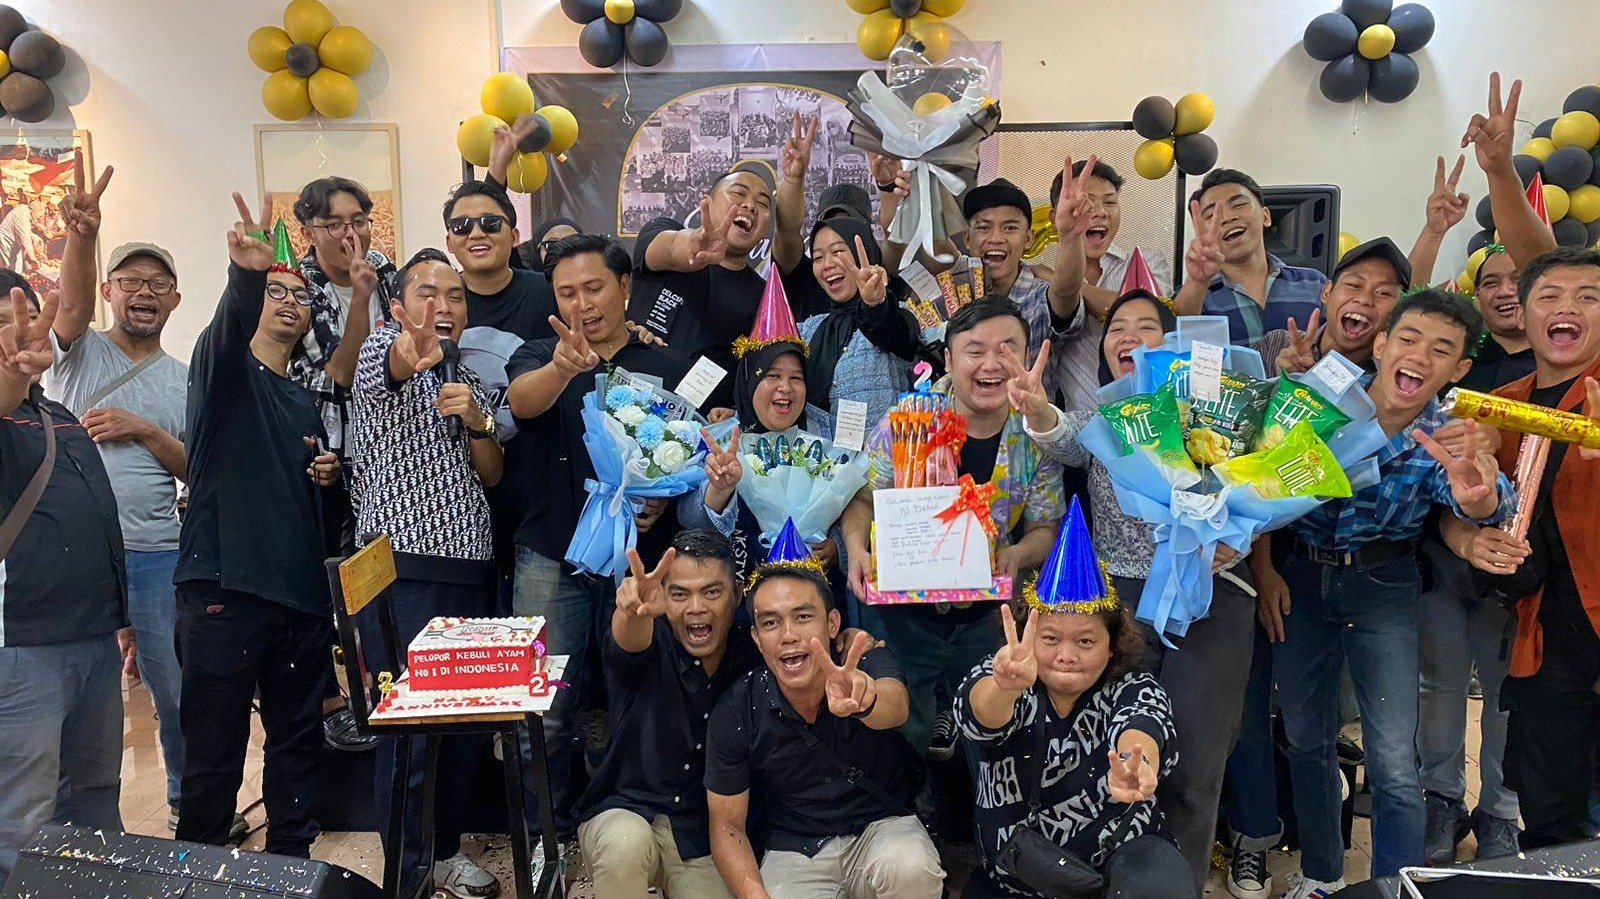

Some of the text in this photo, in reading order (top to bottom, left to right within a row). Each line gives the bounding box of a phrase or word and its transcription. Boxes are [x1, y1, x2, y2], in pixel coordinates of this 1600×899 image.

[913, 361, 932, 390] 2
[1276, 454, 1320, 497] LITE
[413, 649, 525, 663] PELOPOR KEBULI AYAM
[440, 665, 450, 676] DI
[455, 662, 519, 674] INDONESIA
[530, 675, 546, 694] 2
